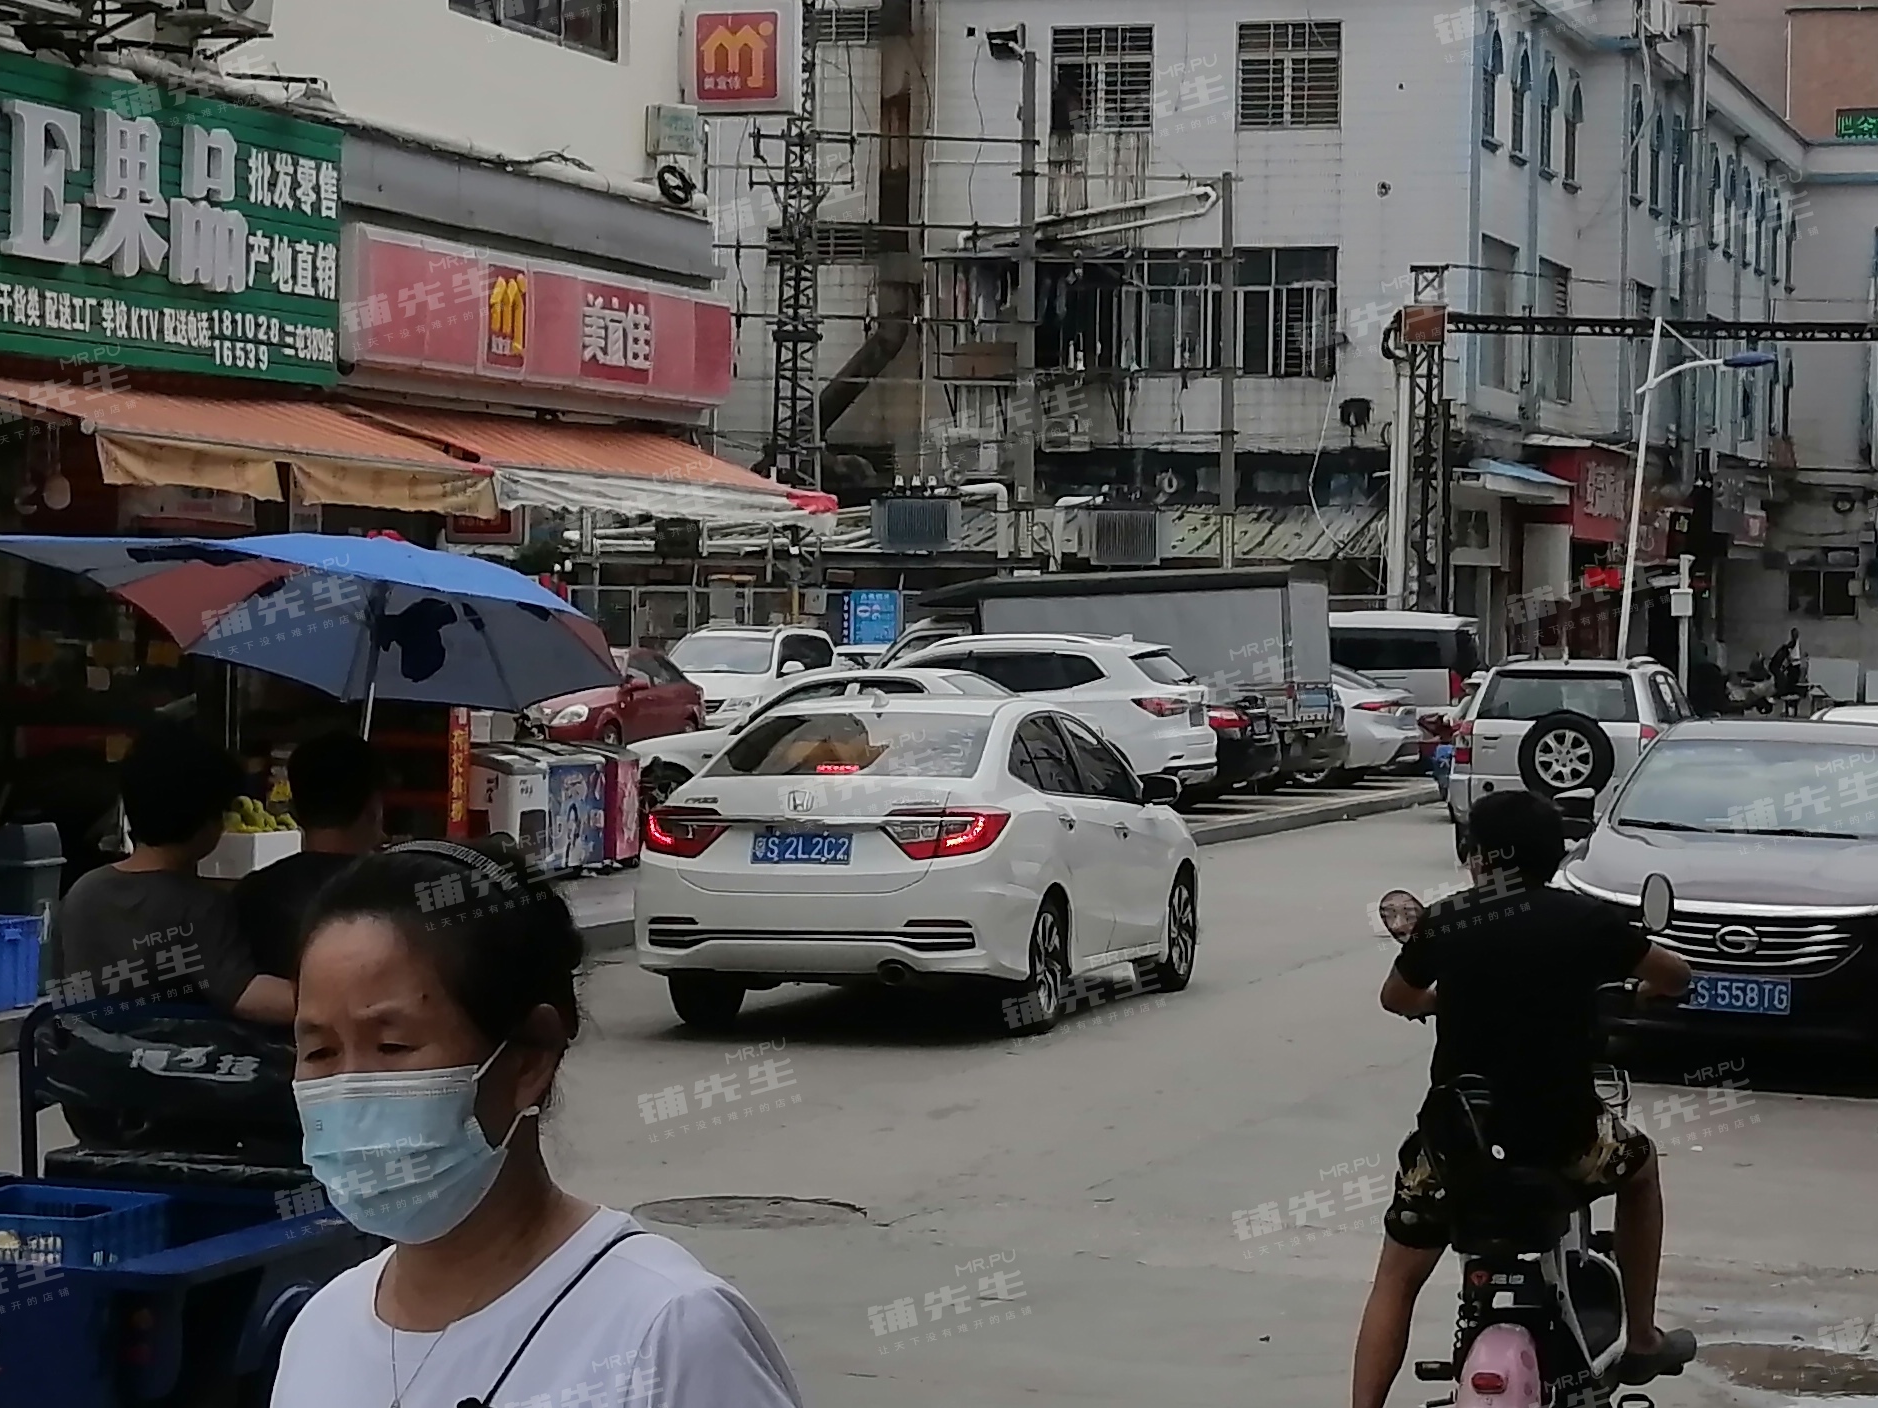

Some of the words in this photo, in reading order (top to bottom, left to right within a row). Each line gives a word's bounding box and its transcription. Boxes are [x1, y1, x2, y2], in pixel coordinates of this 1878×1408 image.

[248, 148, 338, 219] 批发零售
[247, 230, 337, 300] 产地直销
[131, 305, 160, 341] KTV
[582, 293, 653, 370] 美宜佳
